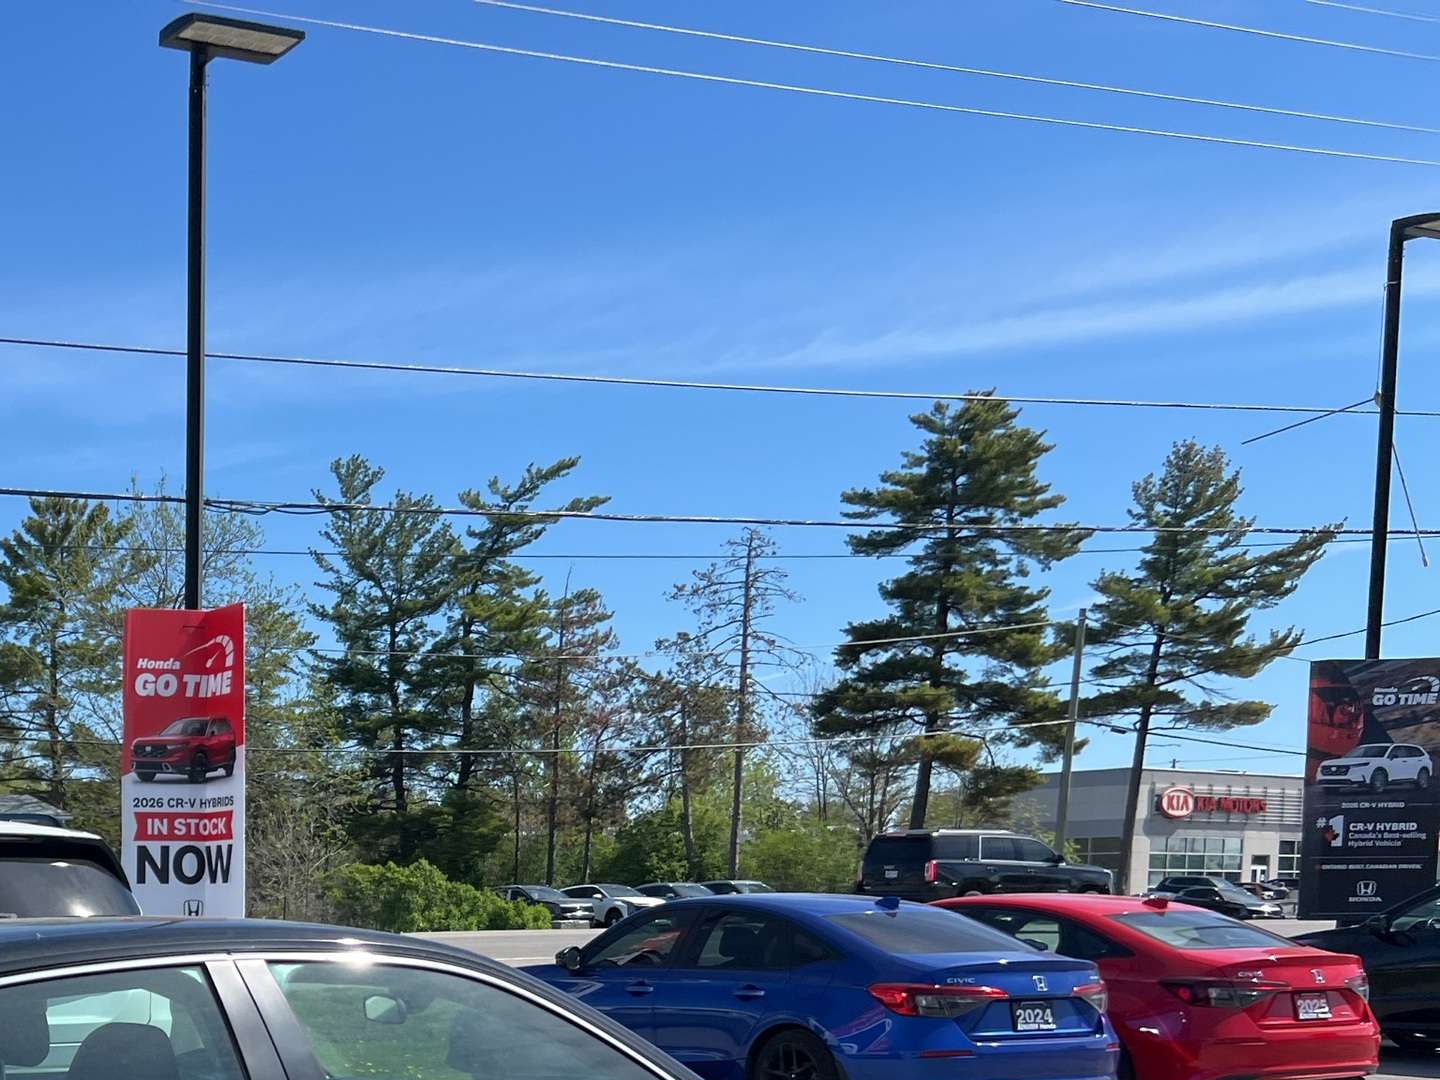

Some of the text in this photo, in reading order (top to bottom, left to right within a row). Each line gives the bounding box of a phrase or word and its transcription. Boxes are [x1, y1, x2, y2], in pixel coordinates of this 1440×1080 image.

[137, 657, 181, 670] Honda
[134, 670, 232, 698] GO TIME
[1372, 692, 1438, 706] GO TIME
[133, 795, 234, 809] 2026 CR-V HYBRIDS
[1167, 794, 1191, 811] KIA
[146, 817, 226, 835] IN STOCK
[1349, 822, 1418, 831] CR-V HYBRID
[136, 844, 233, 885] NOW
[946, 976, 976, 984] CIVIC
[1297, 999, 1329, 1013] 2025
[1016, 1008, 1053, 1023] 2024
